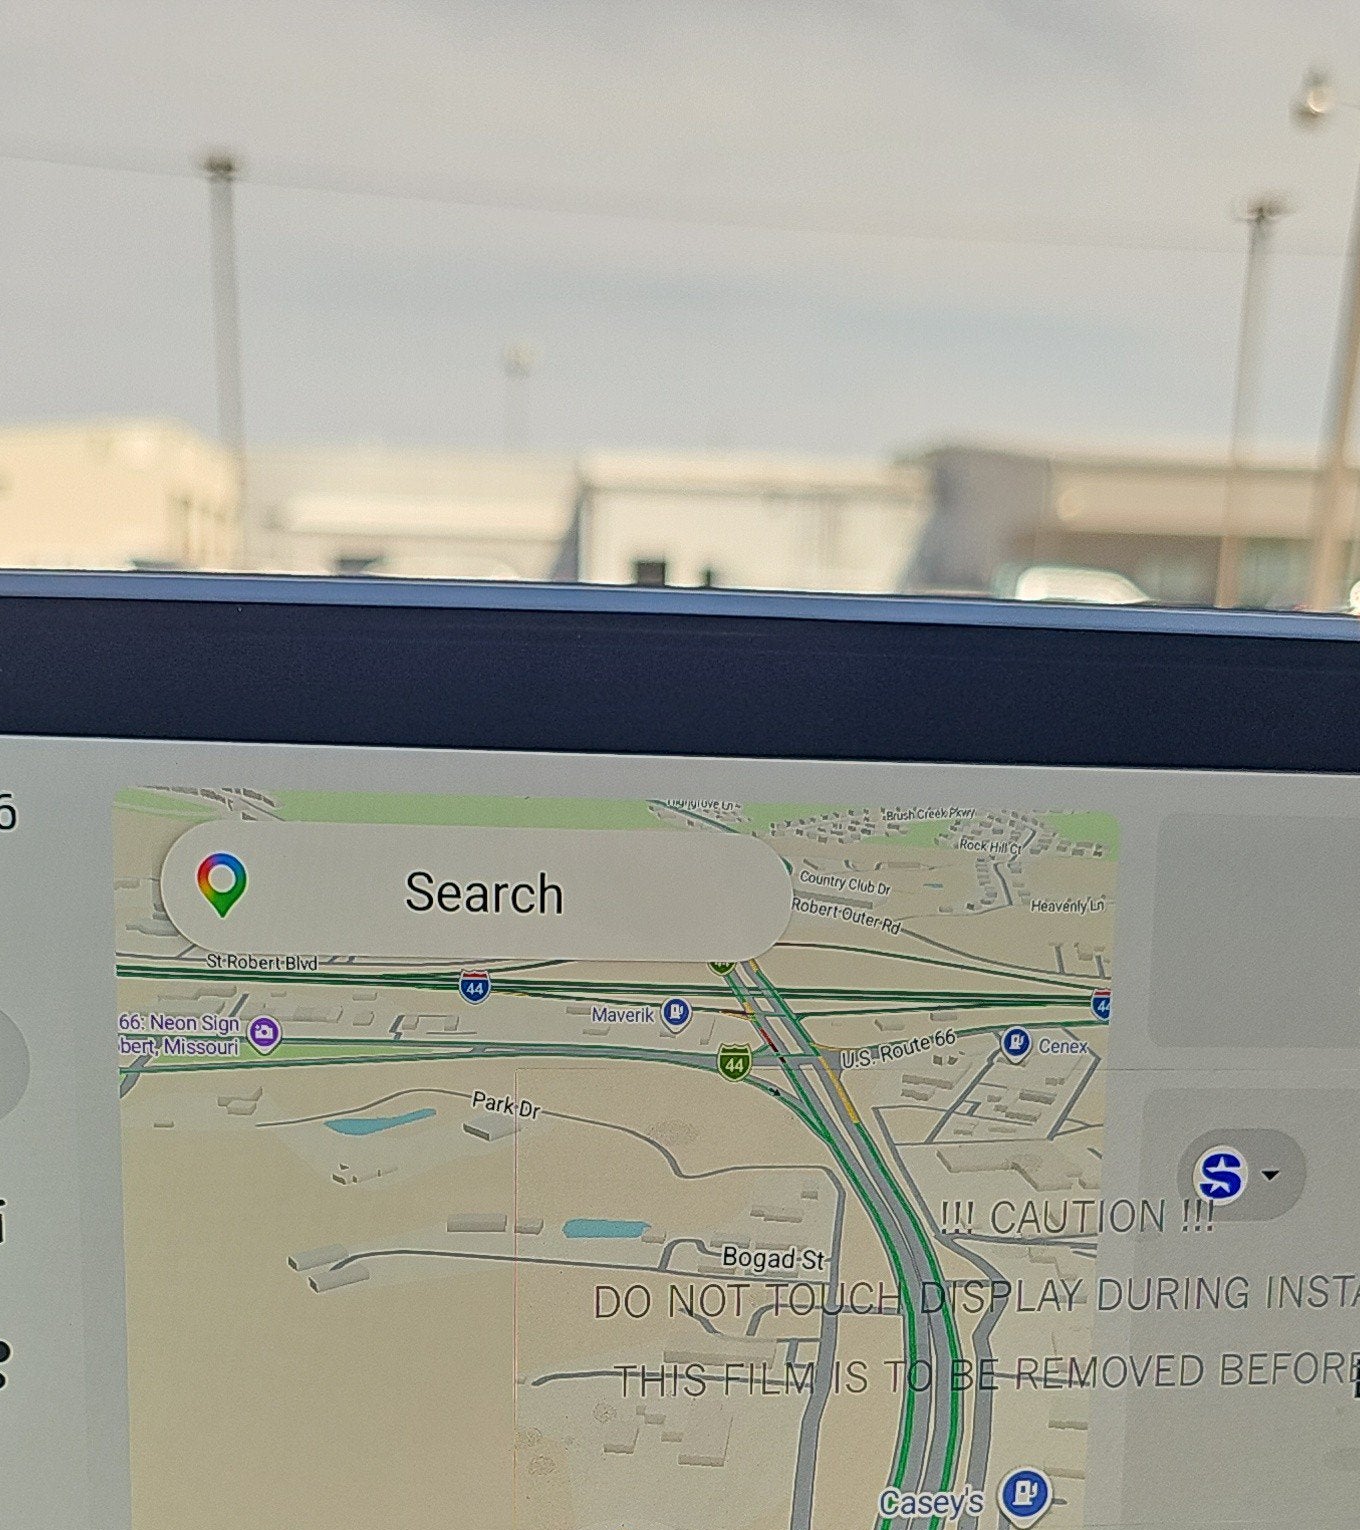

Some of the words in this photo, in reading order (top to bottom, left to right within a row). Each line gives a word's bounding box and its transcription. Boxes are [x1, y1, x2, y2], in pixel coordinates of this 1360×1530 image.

[917, 807, 947, 820] Creek
[960, 838, 987, 851] Rock
[990, 841, 1007, 853] Hill
[1009, 844, 1022, 856] Ct
[405, 871, 565, 915] Search
[800, 870, 847, 892] Country
[848, 878, 875, 894] Club
[877, 882, 891, 896] Dr
[791, 897, 839, 920] Robert
[841, 906, 881, 929] Outer
[881, 918, 902, 936] Rd
[1031, 899, 1089, 915] Heavenly
[1090, 900, 1105, 912] Ln
[207, 953, 220, 969] St
[227, 955, 283, 971] Robert
[285, 956, 318, 972] Blvd
[466, 982, 484, 995] 44
[119, 1015, 145, 1032] 66:
[150, 1014, 199, 1032] Neon
[202, 1014, 240, 1036] Sign
[592, 1006, 654, 1023] Maverik
[118, 1036, 159, 1056] bert,
[164, 1038, 239, 1056] Missouri
[842, 1050, 876, 1069] U.S.
[879, 1038, 930, 1063] Route
[935, 1028, 957, 1047] 66
[1039, 1038, 1088, 1054] Cenex
[725, 1057, 744, 1073] 44
[472, 1090, 514, 1115] Park
[519, 1099, 541, 1119] Dr
[991, 1199, 1165, 1235] CAUTION
[723, 1246, 795, 1271] Bogad
[802, 1249, 824, 1270] St
[594, 1284, 651, 1319] DO
[669, 1283, 751, 1318] NOT
[765, 1282, 902, 1317] TOUCH
[921, 1277, 1084, 1314] DISPLAY
[1098, 1276, 1249, 1312] DURING
[614, 1363, 708, 1399] THIS
[724, 1361, 815, 1397] FILM
[832, 1360, 869, 1394] IS
[883, 1359, 933, 1393] TO
[951, 1358, 1000, 1391] BE
[1016, 1353, 1203, 1391] REMOVED
[879, 1485, 984, 1520] Casey's
